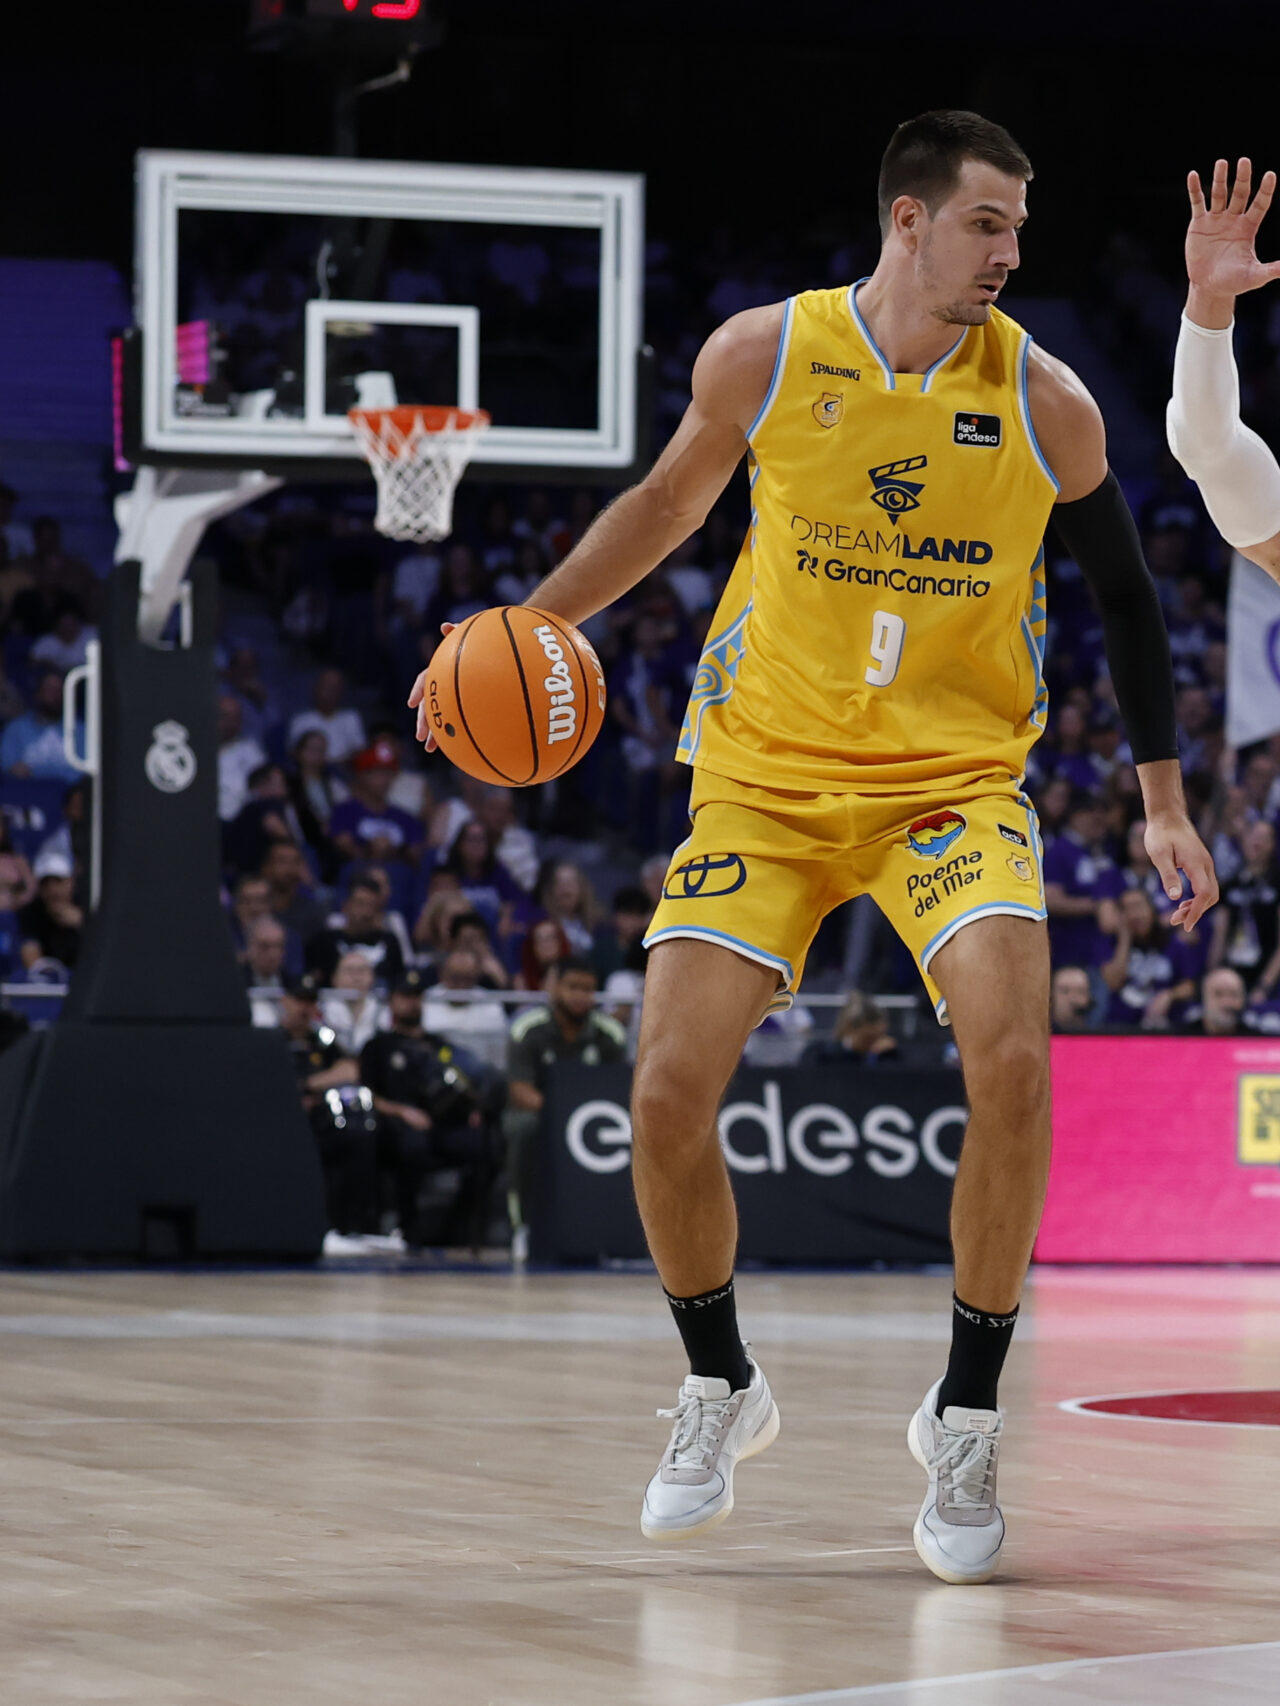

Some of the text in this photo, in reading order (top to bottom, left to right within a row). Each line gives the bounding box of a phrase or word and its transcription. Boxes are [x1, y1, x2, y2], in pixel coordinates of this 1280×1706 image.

[810, 361, 861, 381] SPALDING
[957, 421, 976, 434] liga
[957, 432, 998, 444] endesa
[791, 515, 993, 565] DREAMLAND
[864, 609, 907, 688] 9
[429, 679, 443, 729] acb
[1002, 830, 1022, 844] acb
[906, 850, 984, 898] Poema
[914, 868, 985, 918] del Mar
